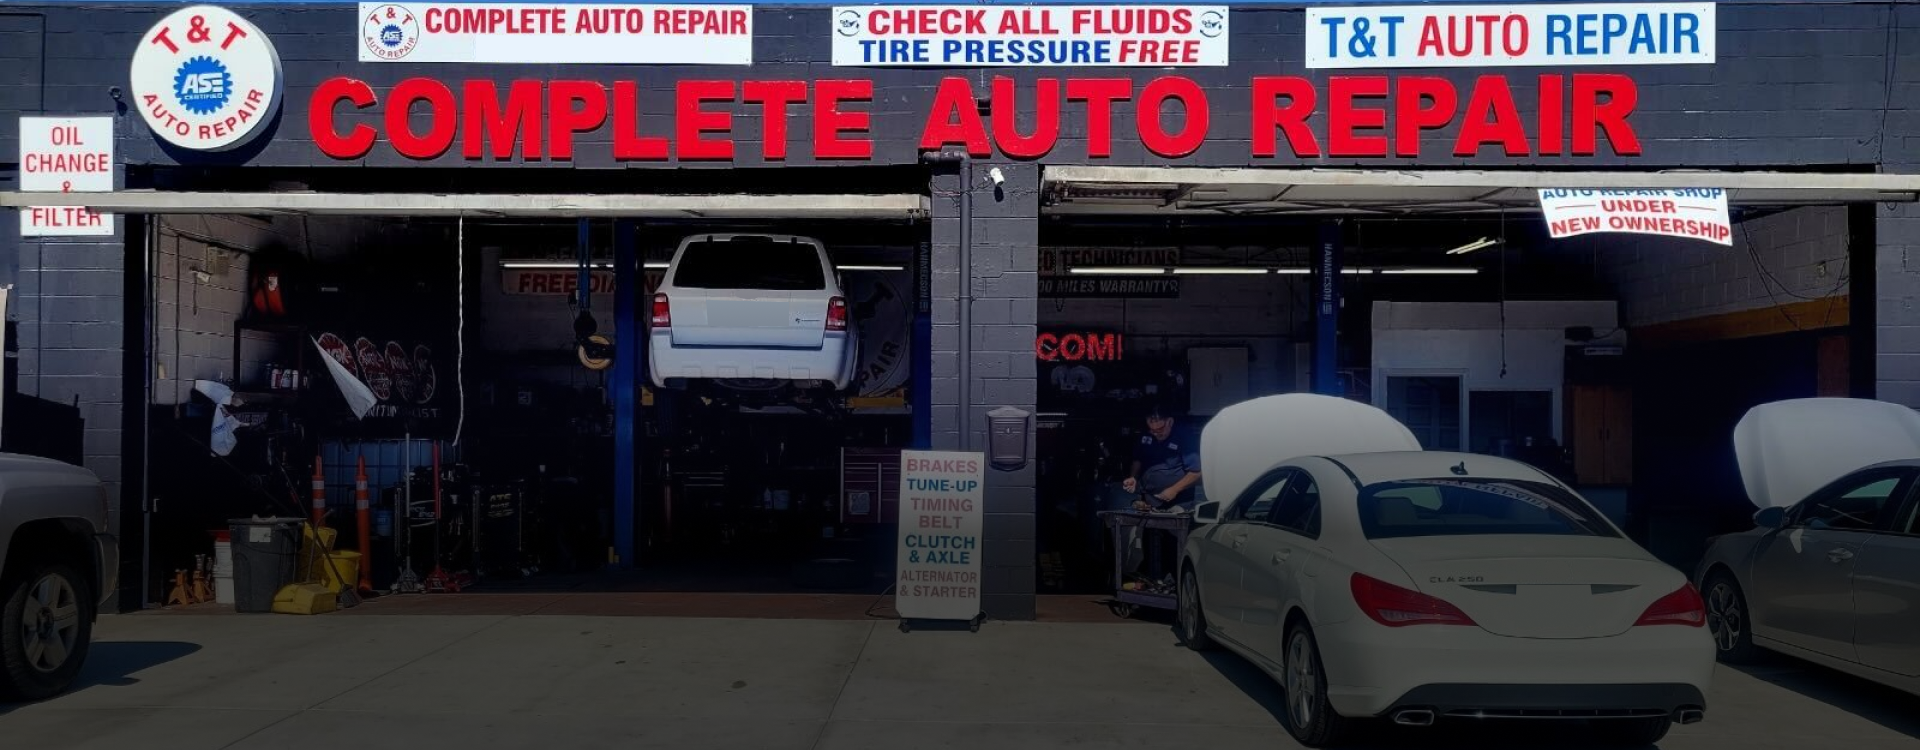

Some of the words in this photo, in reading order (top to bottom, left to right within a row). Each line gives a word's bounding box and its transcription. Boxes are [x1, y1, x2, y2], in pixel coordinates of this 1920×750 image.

[370, 13, 381, 25] T
[386, 7, 396, 19] &
[402, 13, 413, 25] T
[425, 8, 566, 34] COMPLETE
[575, 9, 643, 34] AUTO
[654, 10, 748, 35] REPAIR
[868, 9, 986, 35] CHECK
[998, 10, 1059, 34] ALL
[1072, 9, 1192, 35] FLUIDS
[151, 26, 180, 54] T
[186, 15, 211, 43] &
[220, 21, 247, 50] T
[1320, 16, 1404, 58] T&T
[1417, 14, 1529, 57] AUTO
[1546, 12, 1700, 56] REPAIR
[859, 40, 929, 63] TIRE
[943, 40, 1111, 63] PRESSURE
[1118, 40, 1200, 63] FREE
[181, 72, 224, 94] ASE
[143, 93, 190, 136] AUTO
[199, 88, 264, 139] REPAIR
[308, 77, 873, 161] COMPLETE
[917, 76, 1209, 159] AUTO
[1252, 74, 1644, 157] REPAIR
[52, 126, 84, 146] OIL
[25, 153, 109, 173] CHANGE
[1601, 200, 1676, 213] UNDER
[33, 208, 102, 226] FILTER
[1552, 216, 1600, 236] NEW
[1609, 216, 1730, 241] OWNERSHIP
[519, 273, 578, 293] FREE
[1056, 280, 1096, 293] MILES
[1099, 280, 1172, 293] WARRANTY
[906, 459, 978, 474] BRAKES
[906, 478, 977, 492] TUNE-UP
[911, 498, 973, 512] TIMING
[918, 515, 963, 529] BELT
[905, 534, 975, 549] CLUTCH
[909, 550, 920, 563] &
[926, 550, 970, 564] AXLE
[900, 570, 977, 583] ALTERNATOR
[899, 585, 909, 597] &
[913, 585, 977, 598] STARTER
